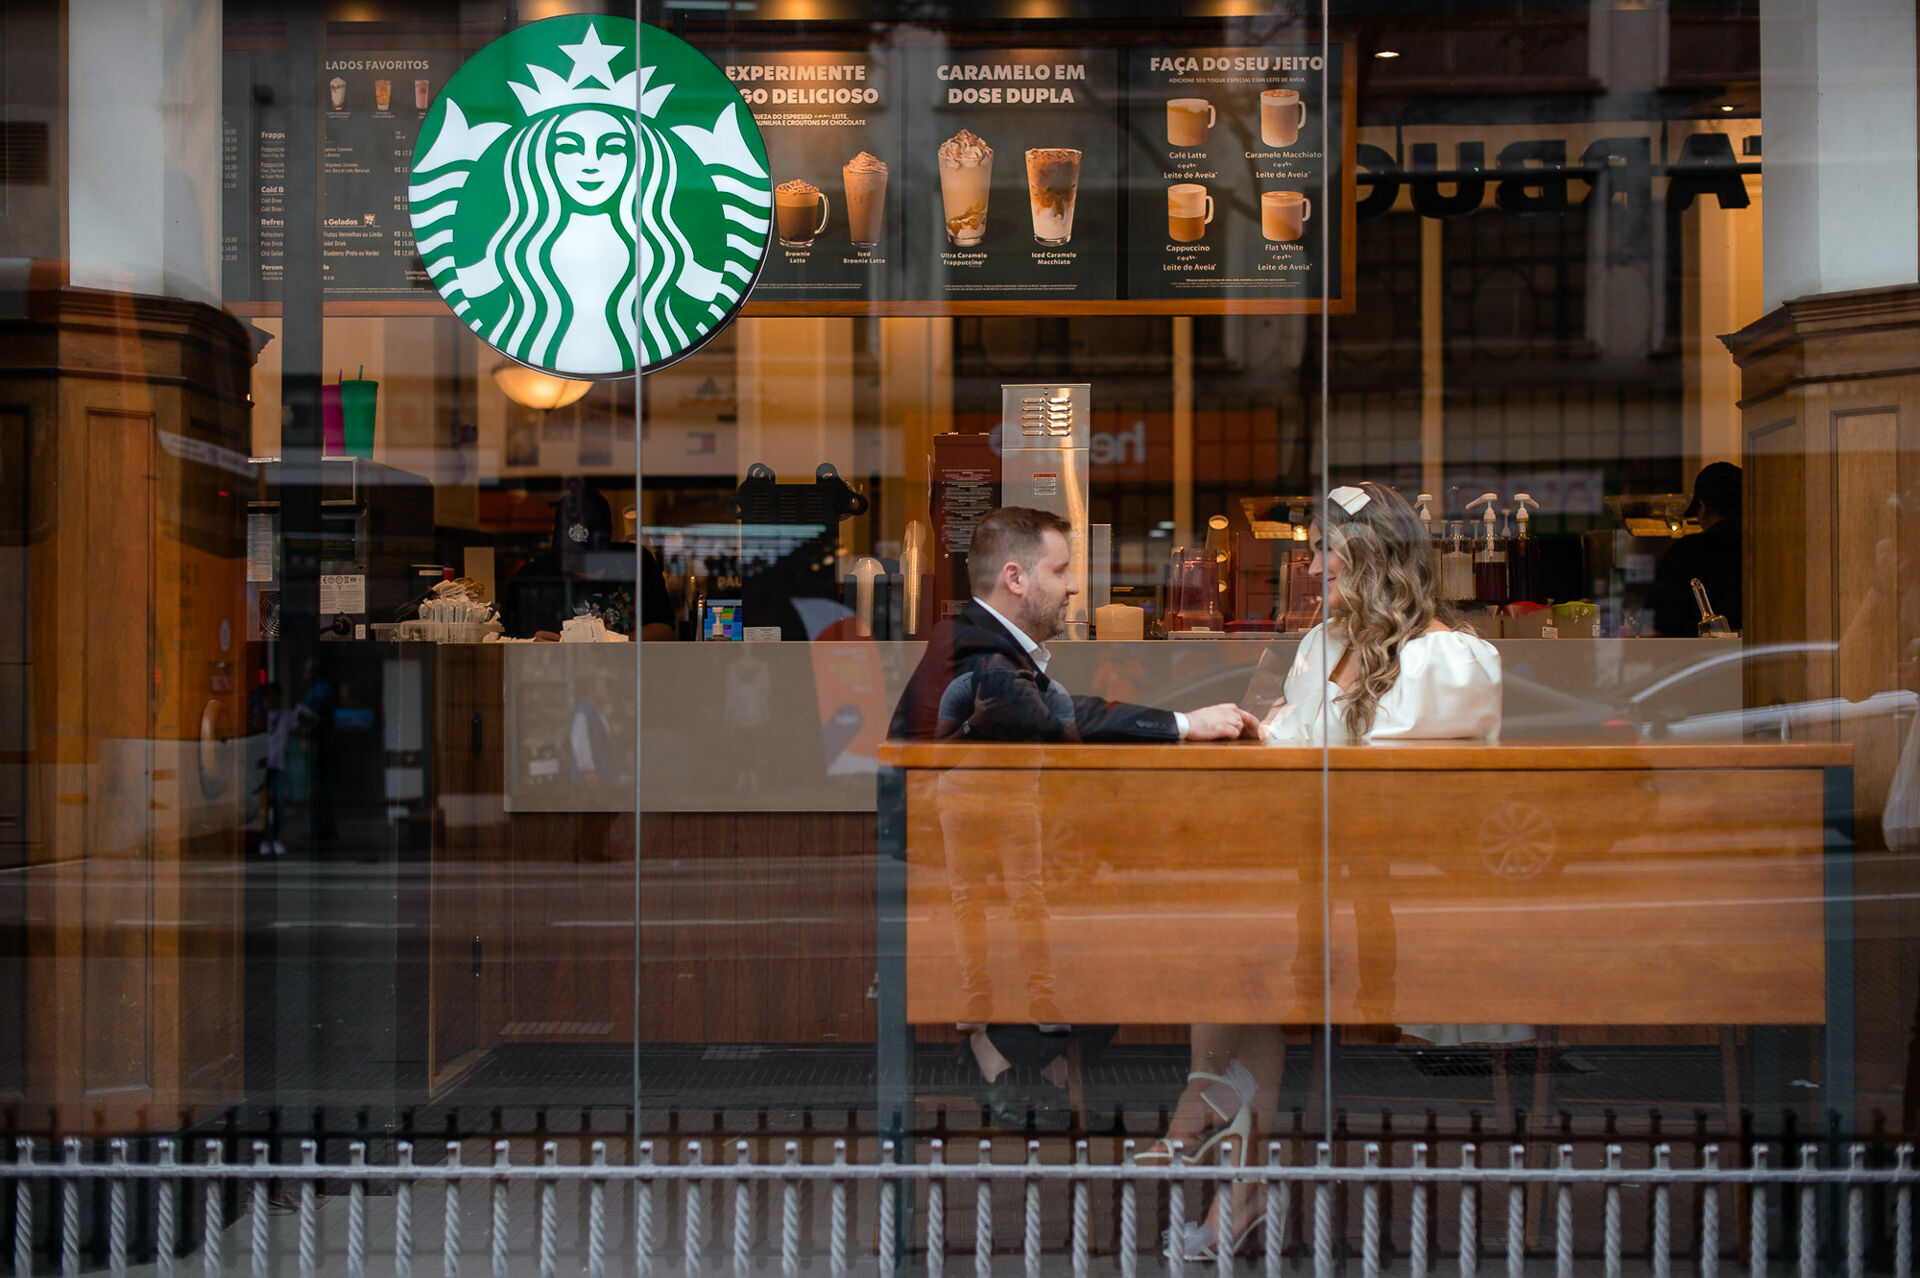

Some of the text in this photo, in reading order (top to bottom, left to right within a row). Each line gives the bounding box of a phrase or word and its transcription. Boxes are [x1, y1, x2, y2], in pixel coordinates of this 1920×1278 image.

[325, 60, 429, 70] LADOS FAVORITOS
[1150, 56, 1324, 75] FAÇA DO SEU JEITO
[725, 65, 866, 81] EXPERIMENTE
[936, 64, 1086, 81] CARAMELO EM
[740, 88, 879, 105] GO DELICIOSO
[948, 88, 1075, 104] DOSE DUPLA
[1245, 151, 1322, 159] Caramelo Macchiato
[1255, 171, 1275, 179] Leite
[1276, 171, 1286, 179] de
[261, 186, 278, 194] Cold
[261, 218, 284, 226] Refres
[328, 218, 358, 226] Gelados
[1166, 244, 1211, 253] Cappuccino
[1258, 263, 1277, 271] Leite
[1278, 263, 1287, 271] de
